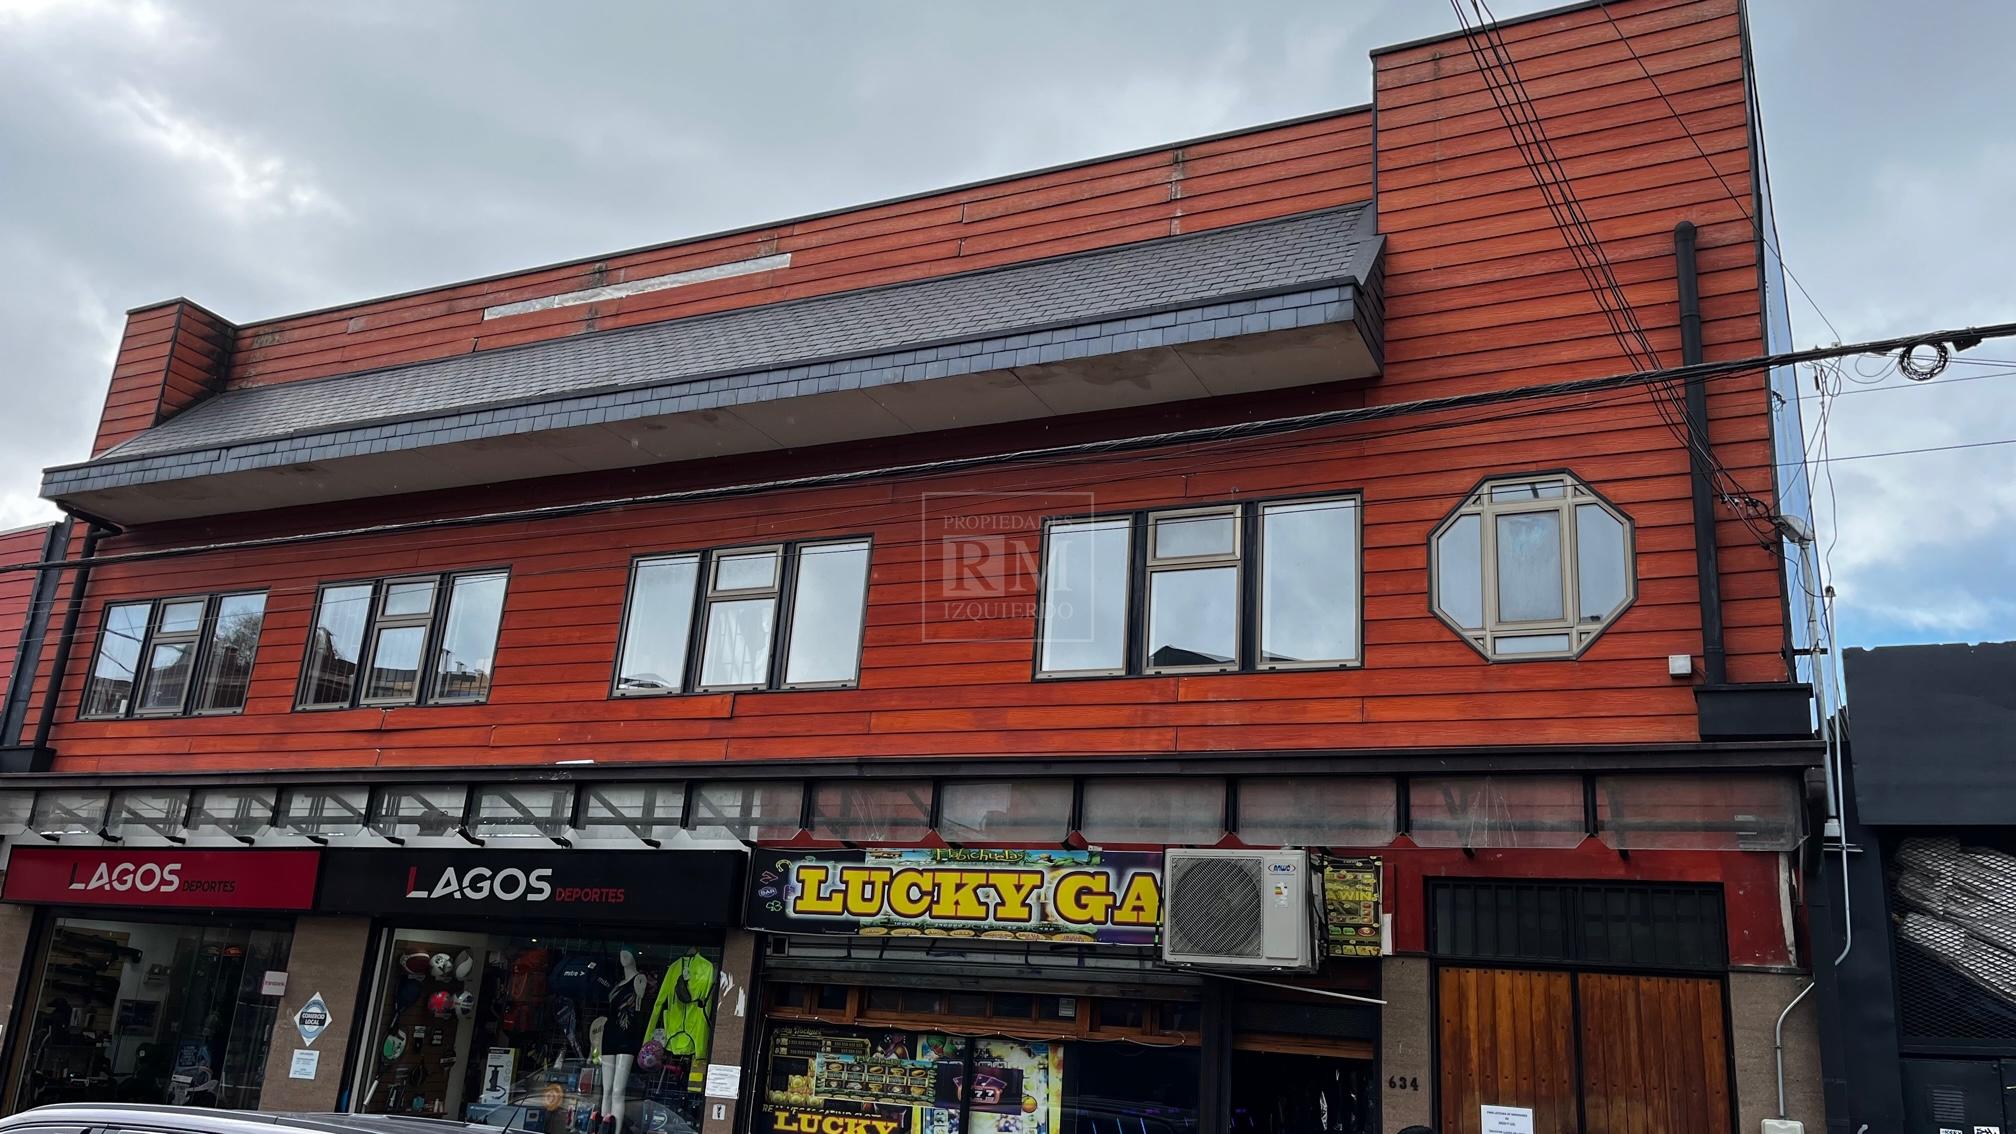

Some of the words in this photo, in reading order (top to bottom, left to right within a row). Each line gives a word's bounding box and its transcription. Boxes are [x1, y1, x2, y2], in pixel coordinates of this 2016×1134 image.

[68, 862, 182, 892] LAGOS
[182, 880, 236, 893] DEPORTES
[406, 866, 553, 901] LAGOS
[555, 887, 625, 903] DEPORTES
[794, 866, 1044, 919] LUCKY
[1389, 1076, 1419, 1091] 634
[773, 1111, 898, 1134] LUCKY
